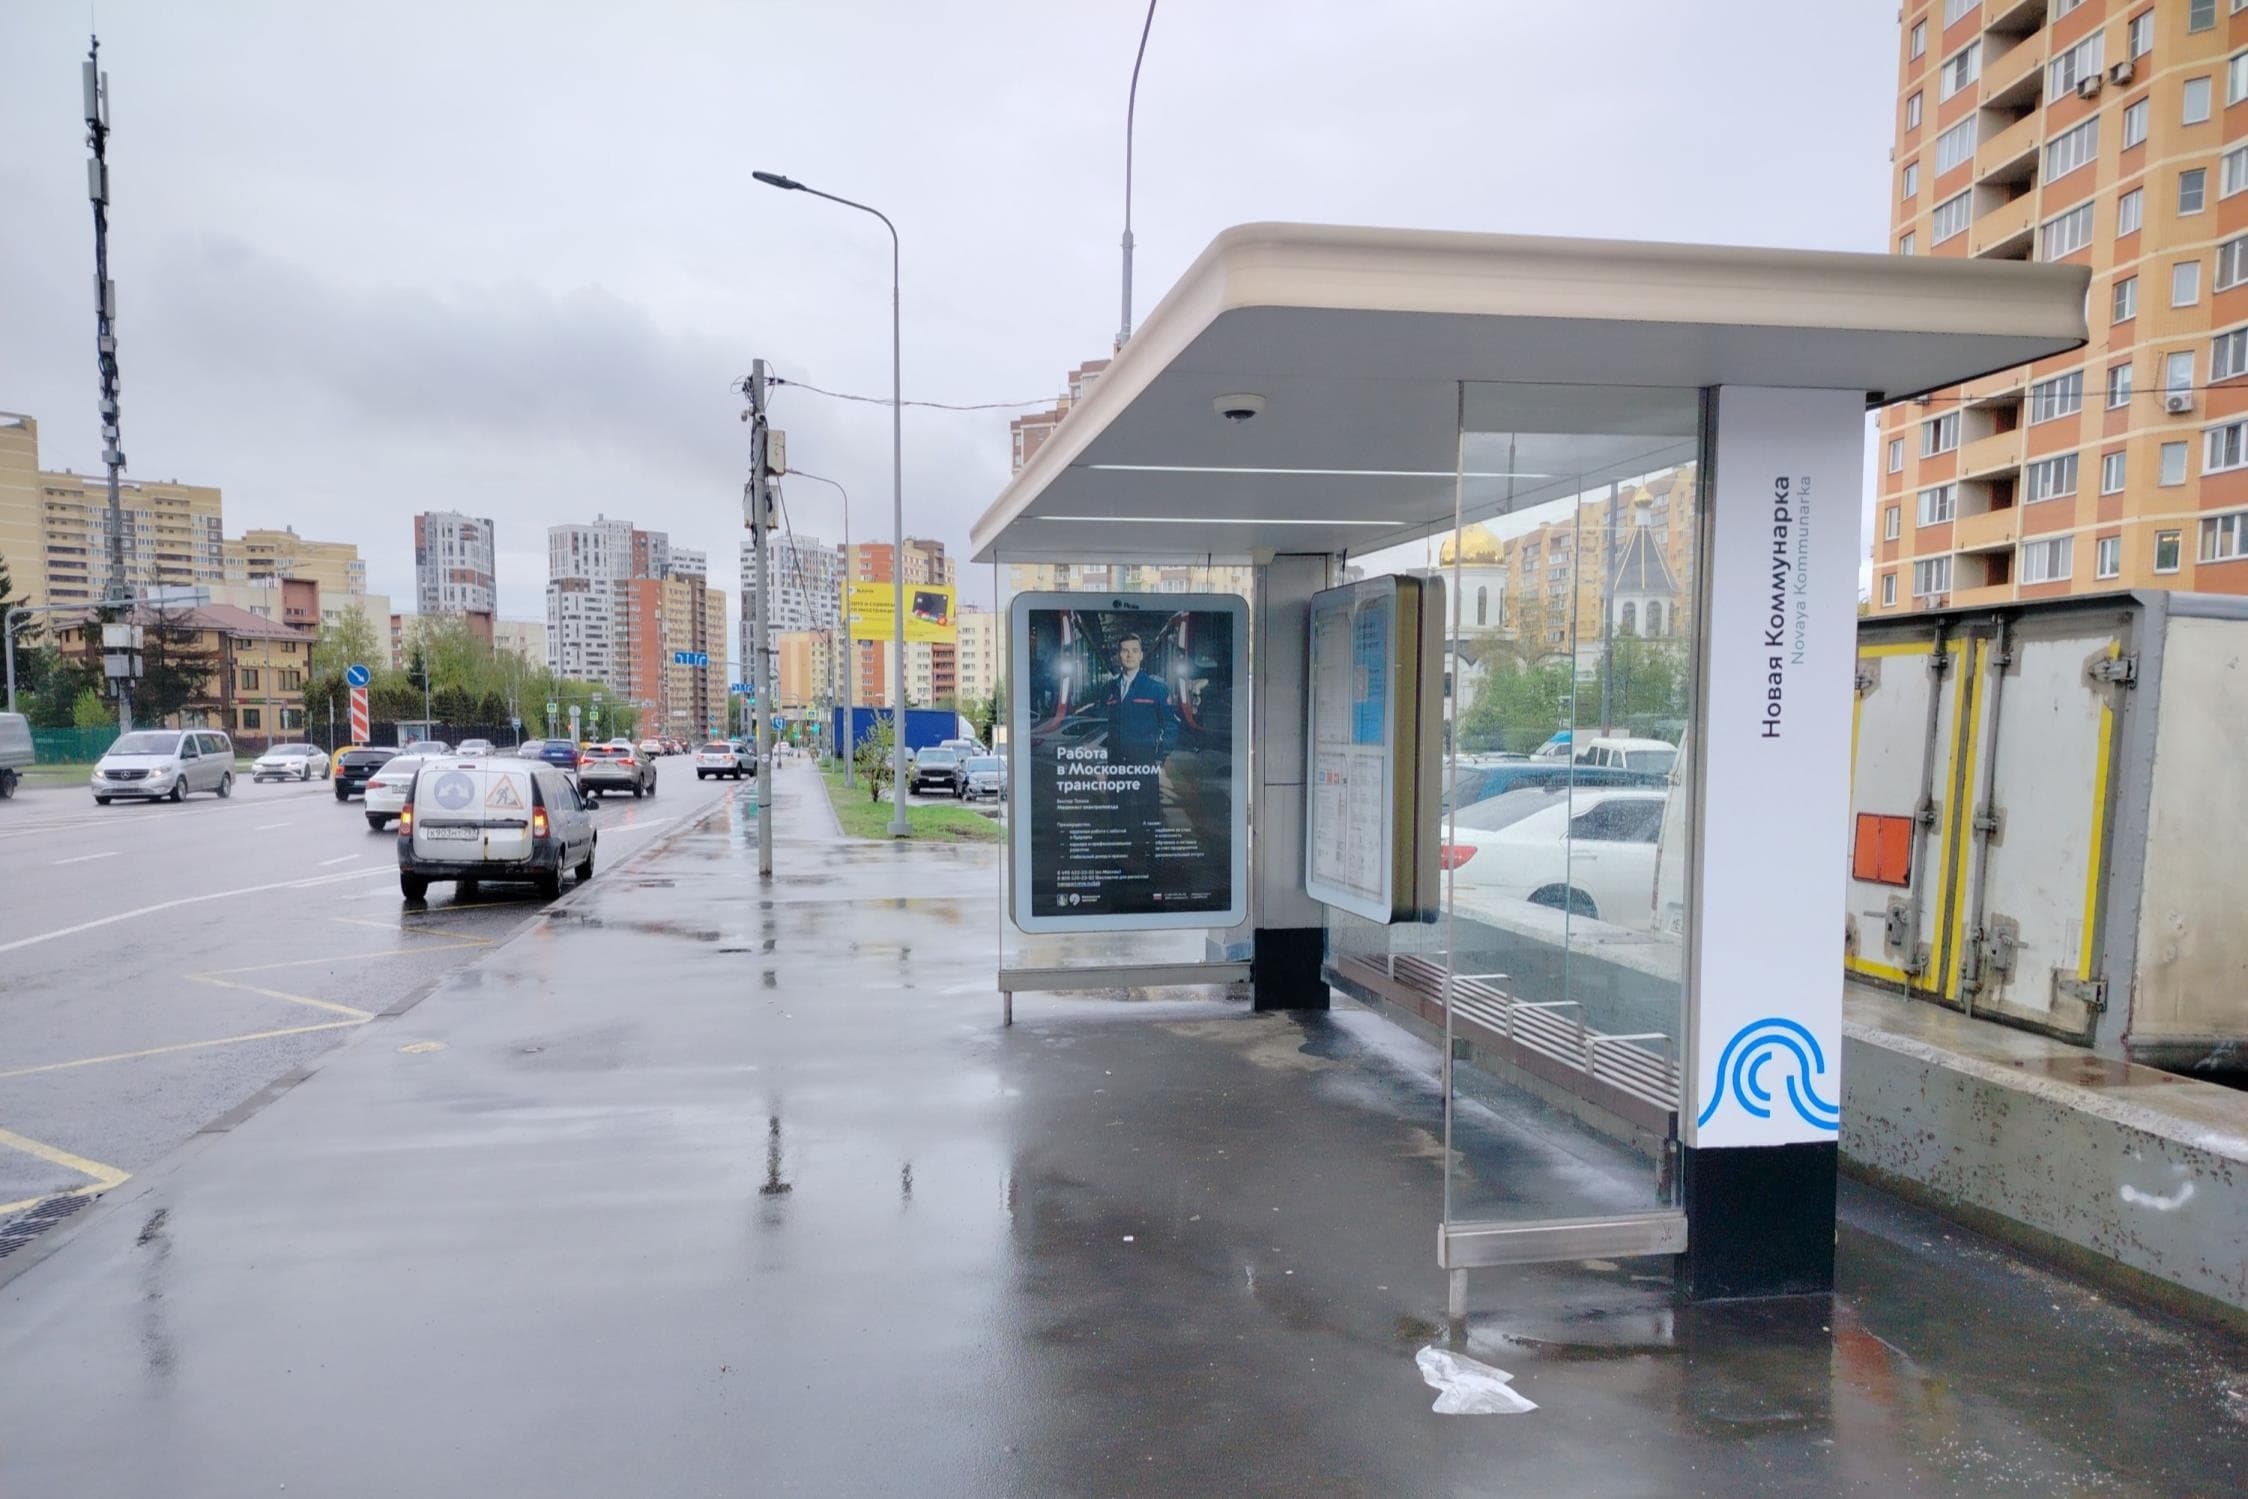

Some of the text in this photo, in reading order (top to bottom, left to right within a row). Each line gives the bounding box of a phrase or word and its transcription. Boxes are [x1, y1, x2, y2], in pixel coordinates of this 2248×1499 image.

[1791, 476, 1811, 665] Novaya Kommunarka
[1761, 476, 1792, 738] Новая Коммунарка
[1057, 746, 1108, 760] Работа
[1057, 762, 1161, 775] в Московском
[1056, 780, 1141, 793] транспорте
